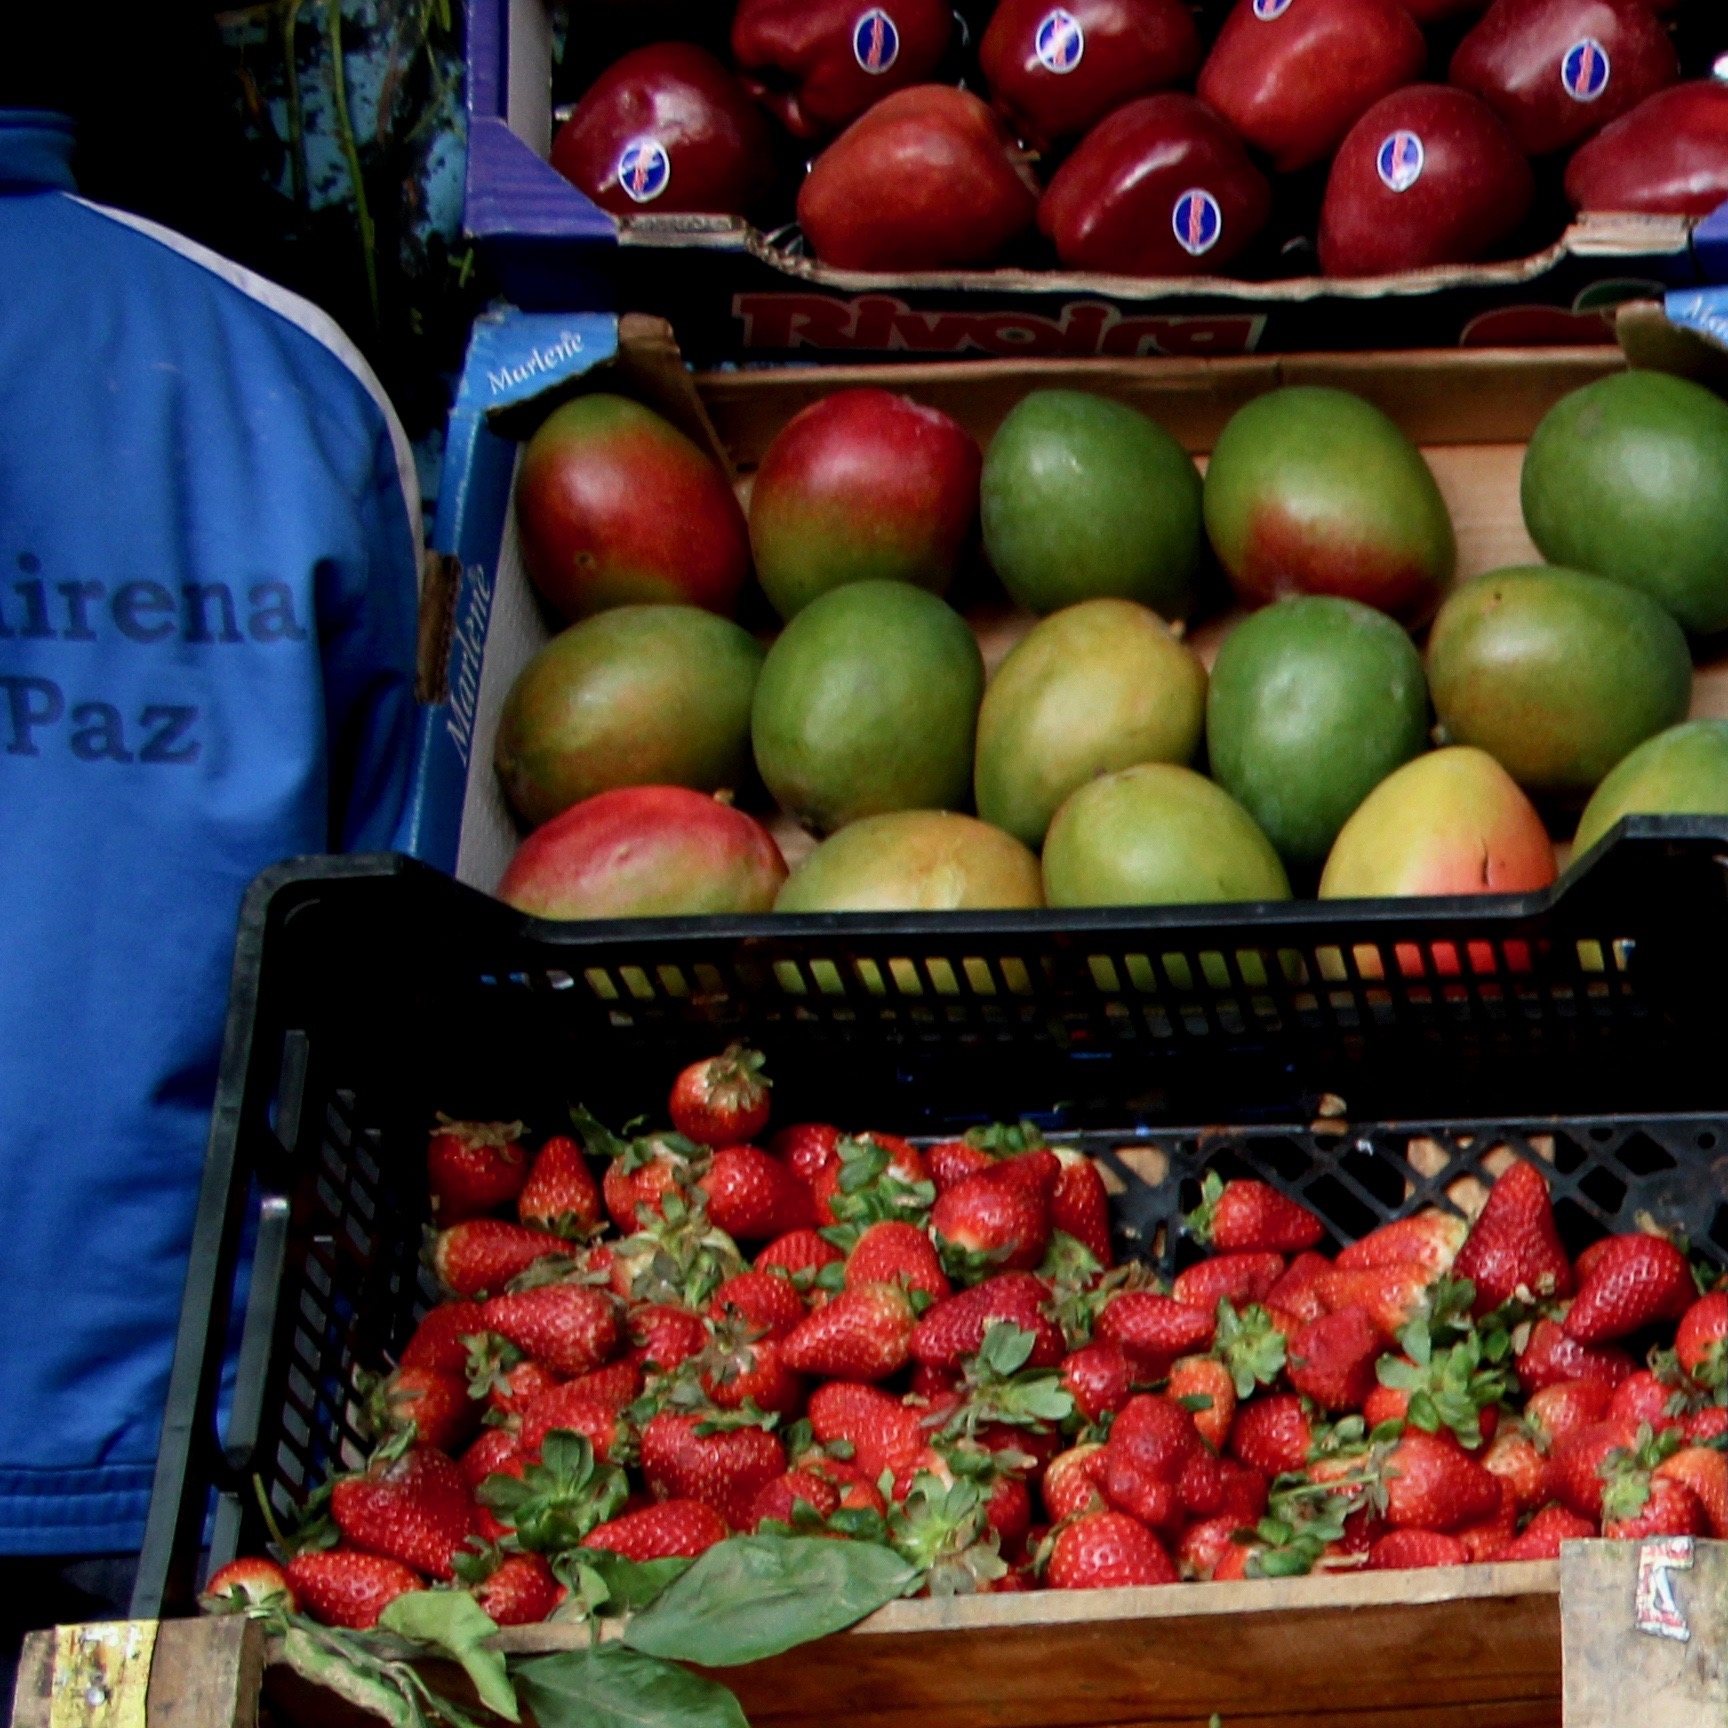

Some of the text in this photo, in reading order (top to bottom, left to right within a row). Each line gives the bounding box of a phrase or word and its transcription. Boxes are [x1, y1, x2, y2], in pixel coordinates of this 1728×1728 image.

[486, 330, 586, 396] Marlene
[732, 293, 1267, 357] Rivoira
[0, 552, 309, 644] irena
[0, 675, 201, 764] Paz
